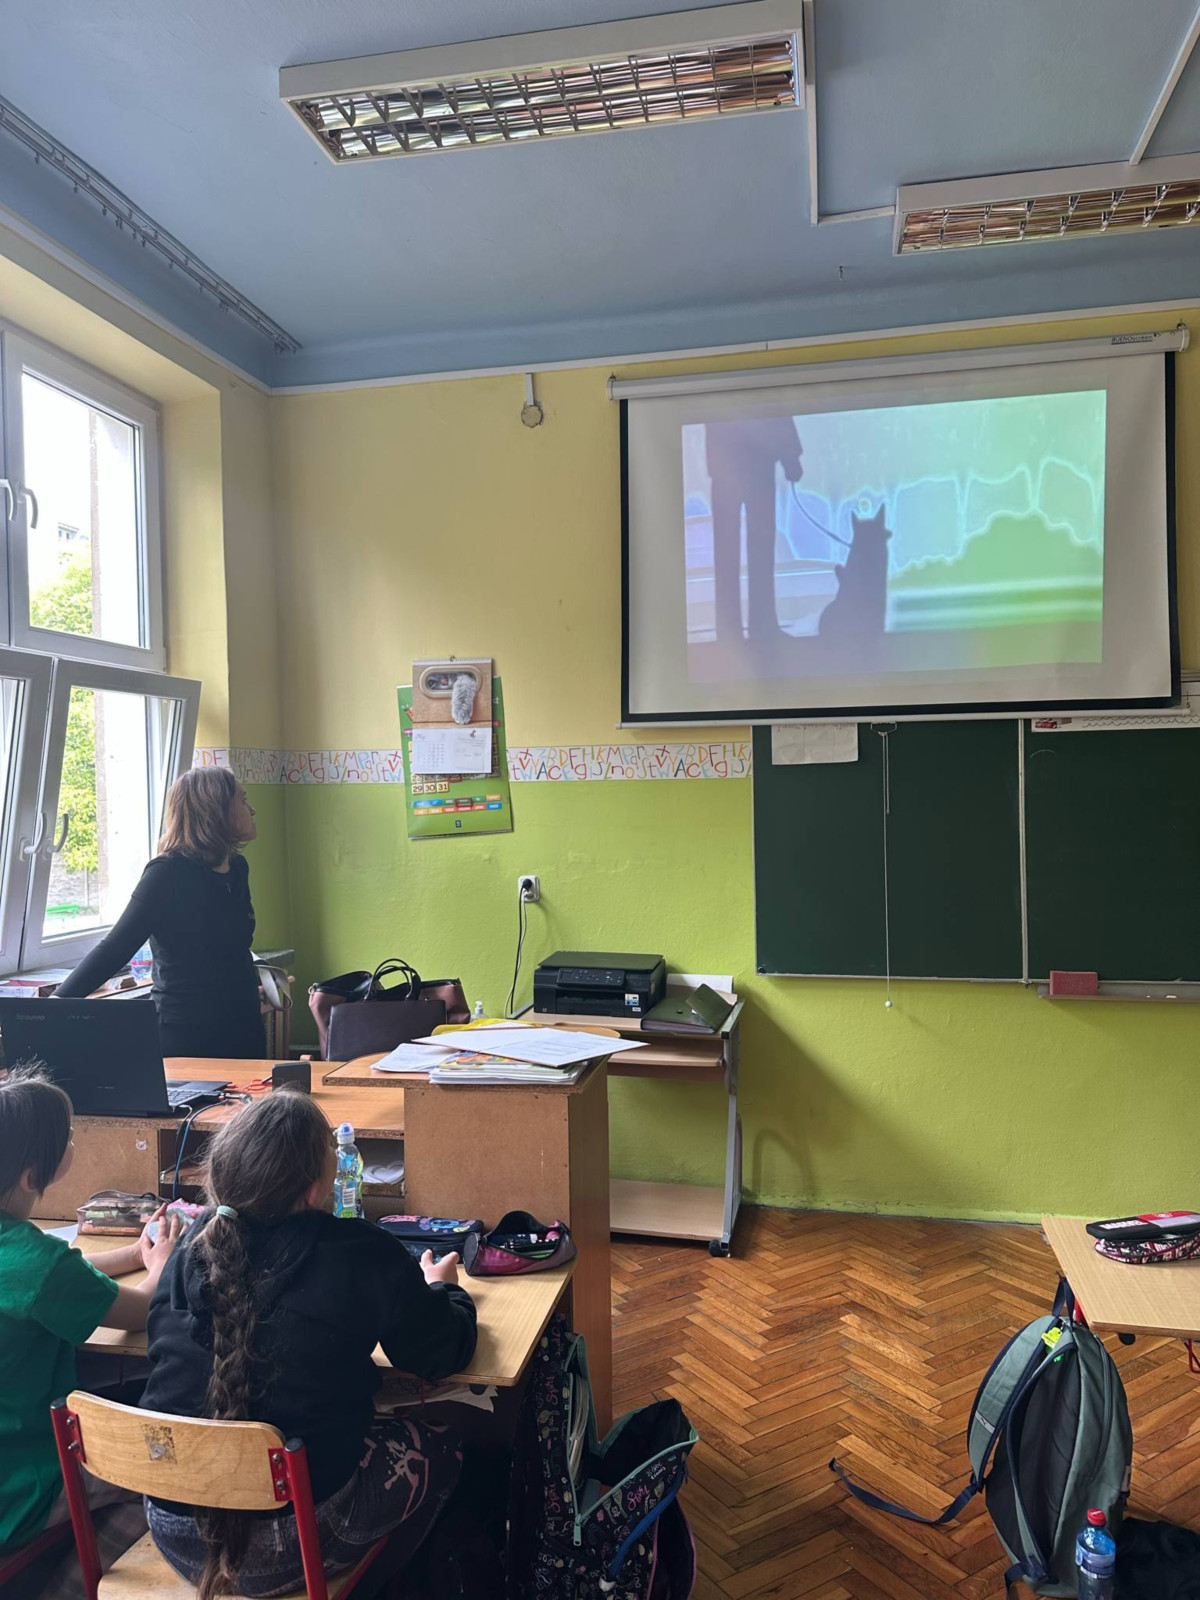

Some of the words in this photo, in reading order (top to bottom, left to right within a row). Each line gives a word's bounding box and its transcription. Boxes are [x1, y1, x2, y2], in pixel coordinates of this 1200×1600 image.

[202, 750, 213, 765] D
[308, 752, 320, 773] F
[321, 751, 333, 765] H
[343, 752, 359, 769] M
[559, 749, 569, 766] D
[569, 748, 581, 770] F
[583, 745, 594, 762] H
[606, 747, 623, 765] M
[698, 745, 708, 763] D
[709, 744, 722, 767] F
[723, 743, 736, 759] H
[280, 765, 288, 782] A
[536, 762, 548, 780] A
[674, 758, 687, 777] A
